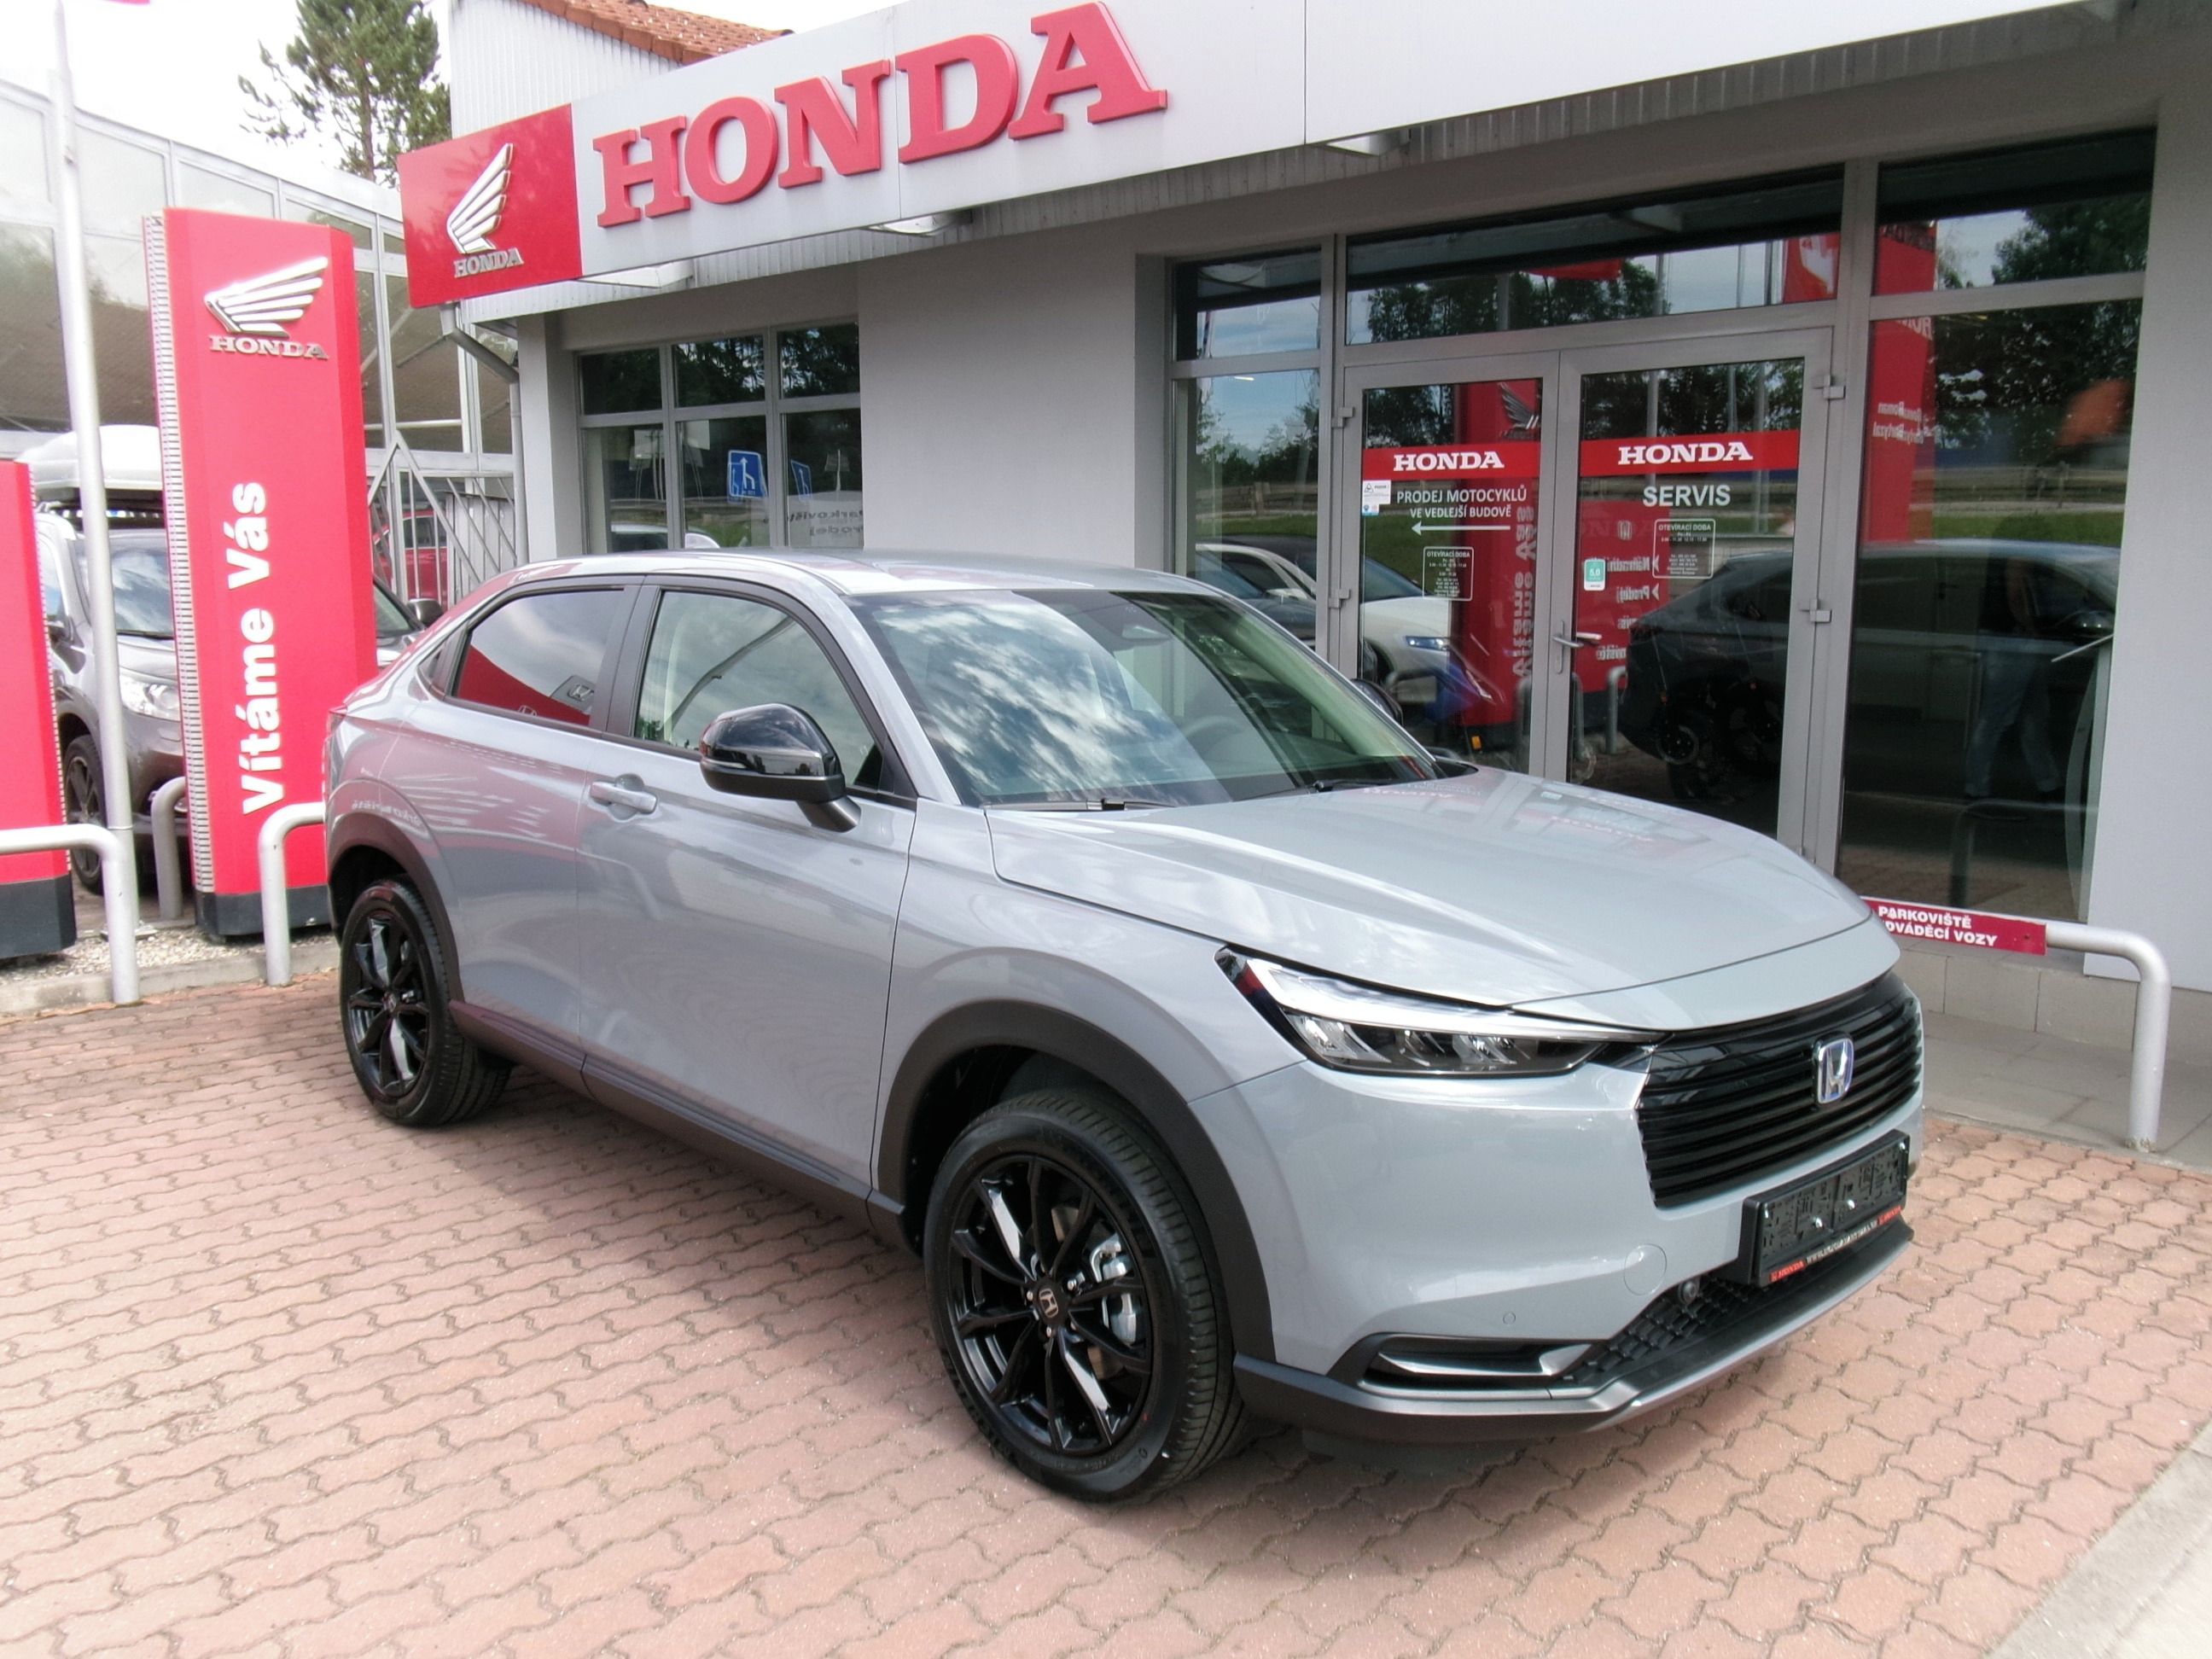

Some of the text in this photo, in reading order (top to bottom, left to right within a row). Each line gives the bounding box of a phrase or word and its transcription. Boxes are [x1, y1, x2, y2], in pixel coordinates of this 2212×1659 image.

[592, 1, 1168, 228] HONDA
[453, 247, 525, 278] HONDA
[209, 335, 329, 360] HONDA
[1393, 451, 1505, 471] HONDA
[1618, 441, 1754, 465] HONDA
[1397, 485, 1527, 504] PRODEJ MOTOCYKLŮ
[1643, 484, 1731, 507] SERVIS
[1411, 504, 1511, 518] VE VEDLEJŠÍ BUDOVĚ
[223, 482, 285, 815] Vítáme Vás
[1878, 905, 1972, 928] PARKOVIŠTĚ
[1883, 921, 1998, 946] DVÁDĚCÍ VOZY
